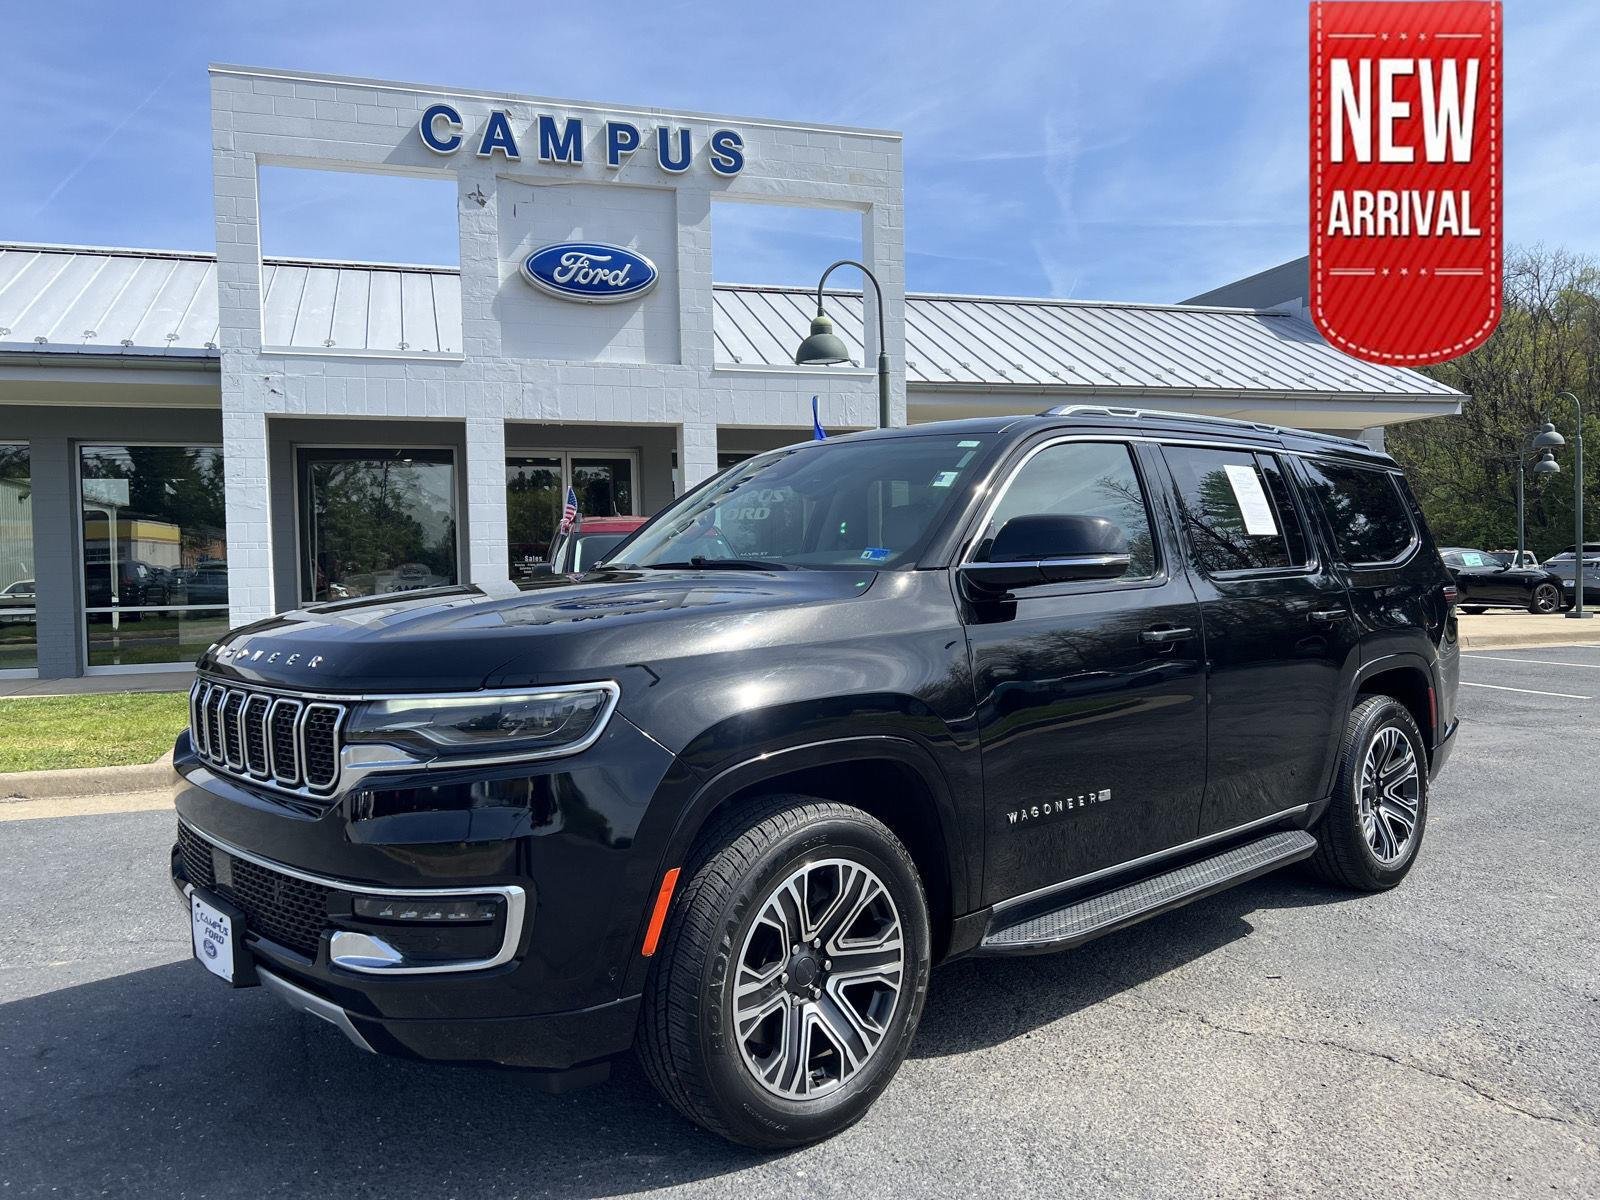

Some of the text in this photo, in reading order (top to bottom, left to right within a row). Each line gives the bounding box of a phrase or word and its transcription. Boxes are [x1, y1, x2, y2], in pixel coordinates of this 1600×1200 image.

[418, 102, 747, 178] CAMPUS
[553, 251, 633, 287] Ford
[1006, 793, 1097, 824] WAGONEER
[200, 912, 229, 937] CAMPUS
[204, 926, 225, 945] FORD
